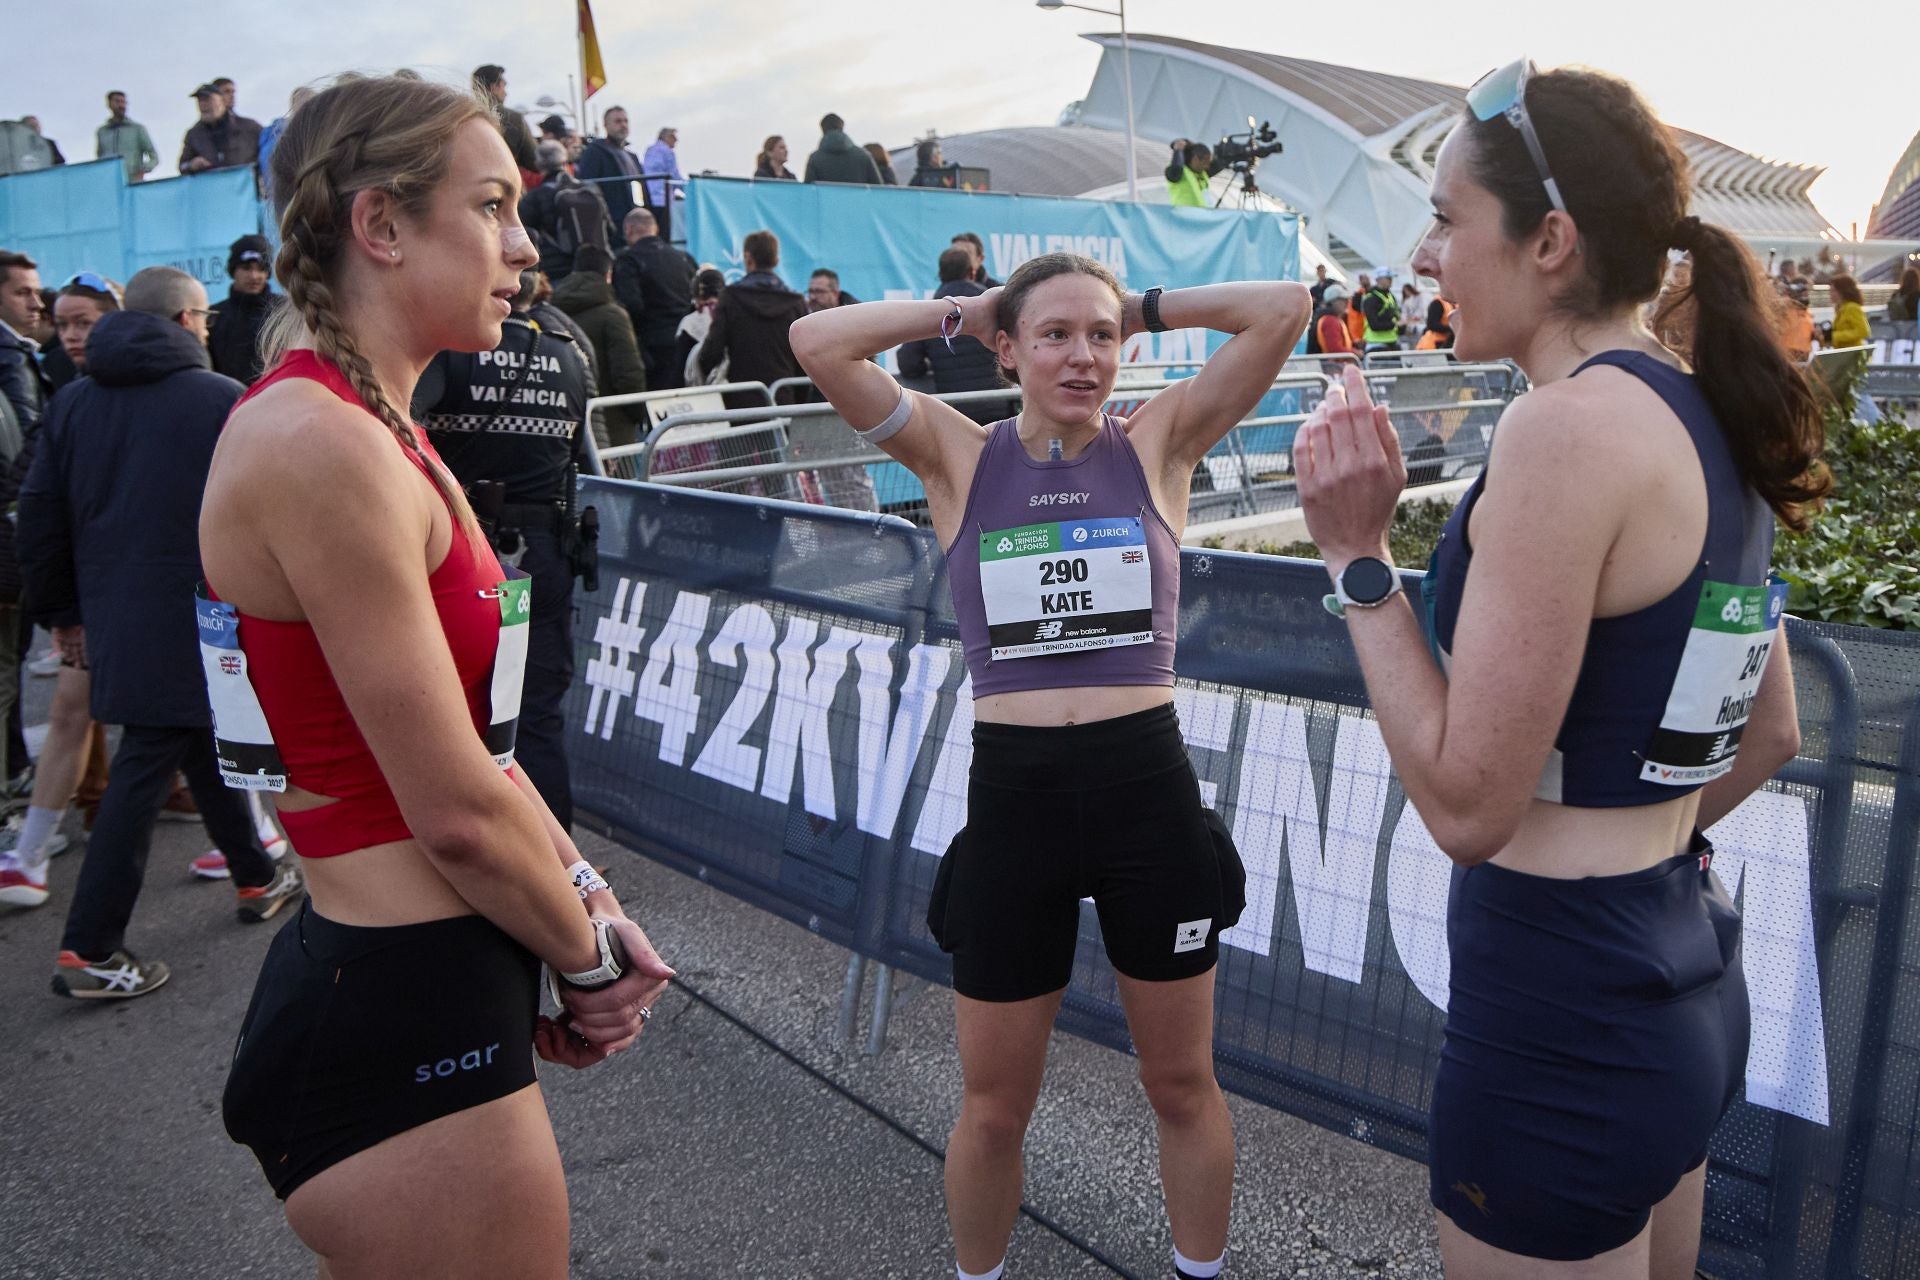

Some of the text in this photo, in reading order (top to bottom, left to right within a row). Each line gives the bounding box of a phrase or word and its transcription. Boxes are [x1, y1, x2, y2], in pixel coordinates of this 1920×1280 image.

[479, 351, 562, 373] POLICIA
[500, 369, 545, 383] LOAL
[1029, 492, 1090, 507] SAYSKY
[1092, 527, 1129, 538] ZURICH
[1015, 534, 1049, 546] TRINIDAD
[1015, 541, 1050, 552] ALFONSO
[1039, 557, 1089, 586] 290
[1041, 590, 1094, 615] KATE
[1080, 627, 1107, 636] balance
[1042, 642, 1075, 651] TRINIDAD
[1075, 638, 1107, 648] ALFONSO
[1739, 642, 1770, 681] 247
[415, 1042, 500, 1083] soar
